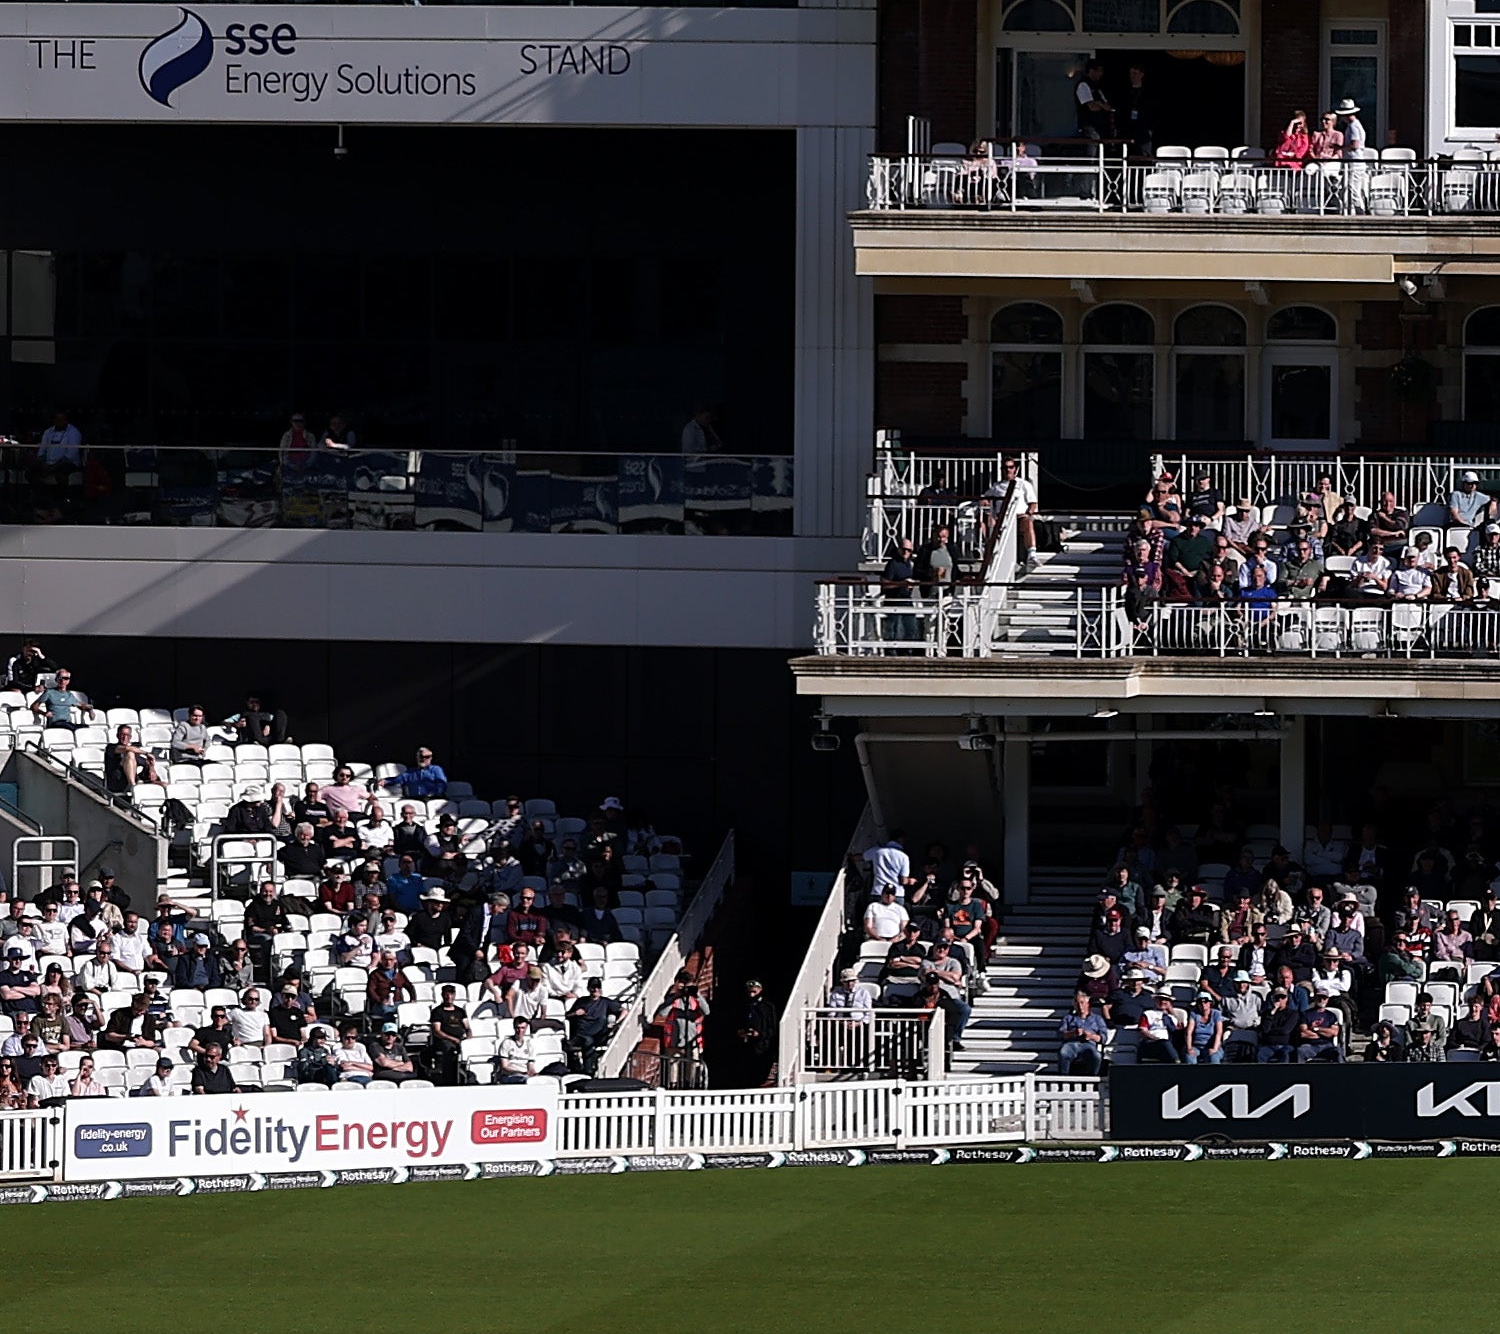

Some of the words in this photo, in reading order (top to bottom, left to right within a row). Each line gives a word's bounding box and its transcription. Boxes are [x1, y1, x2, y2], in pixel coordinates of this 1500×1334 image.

[224, 22, 298, 56] sse
[29, 40, 97, 70] THE
[519, 43, 632, 76] STAND
[226, 64, 326, 103] Energy
[336, 64, 476, 97] Solutions
[1161, 1083, 1311, 1120] KIA
[485, 1113, 535, 1128] Energising
[80, 1127, 147, 1144] fidelity-energy
[481, 1127, 499, 1139] Our
[501, 1124, 541, 1138] Partners
[99, 1141, 129, 1153] .co.uk
[1124, 1146, 1182, 1159] Rothesay
[1293, 1145, 1350, 1157] Rothesay
[788, 1152, 846, 1163] Rothesay
[956, 1148, 1014, 1161] Rothesay
[340, 1168, 391, 1181] Rothesay
[484, 1162, 535, 1175] Rothesay
[197, 1176, 248, 1189] Rothesay
